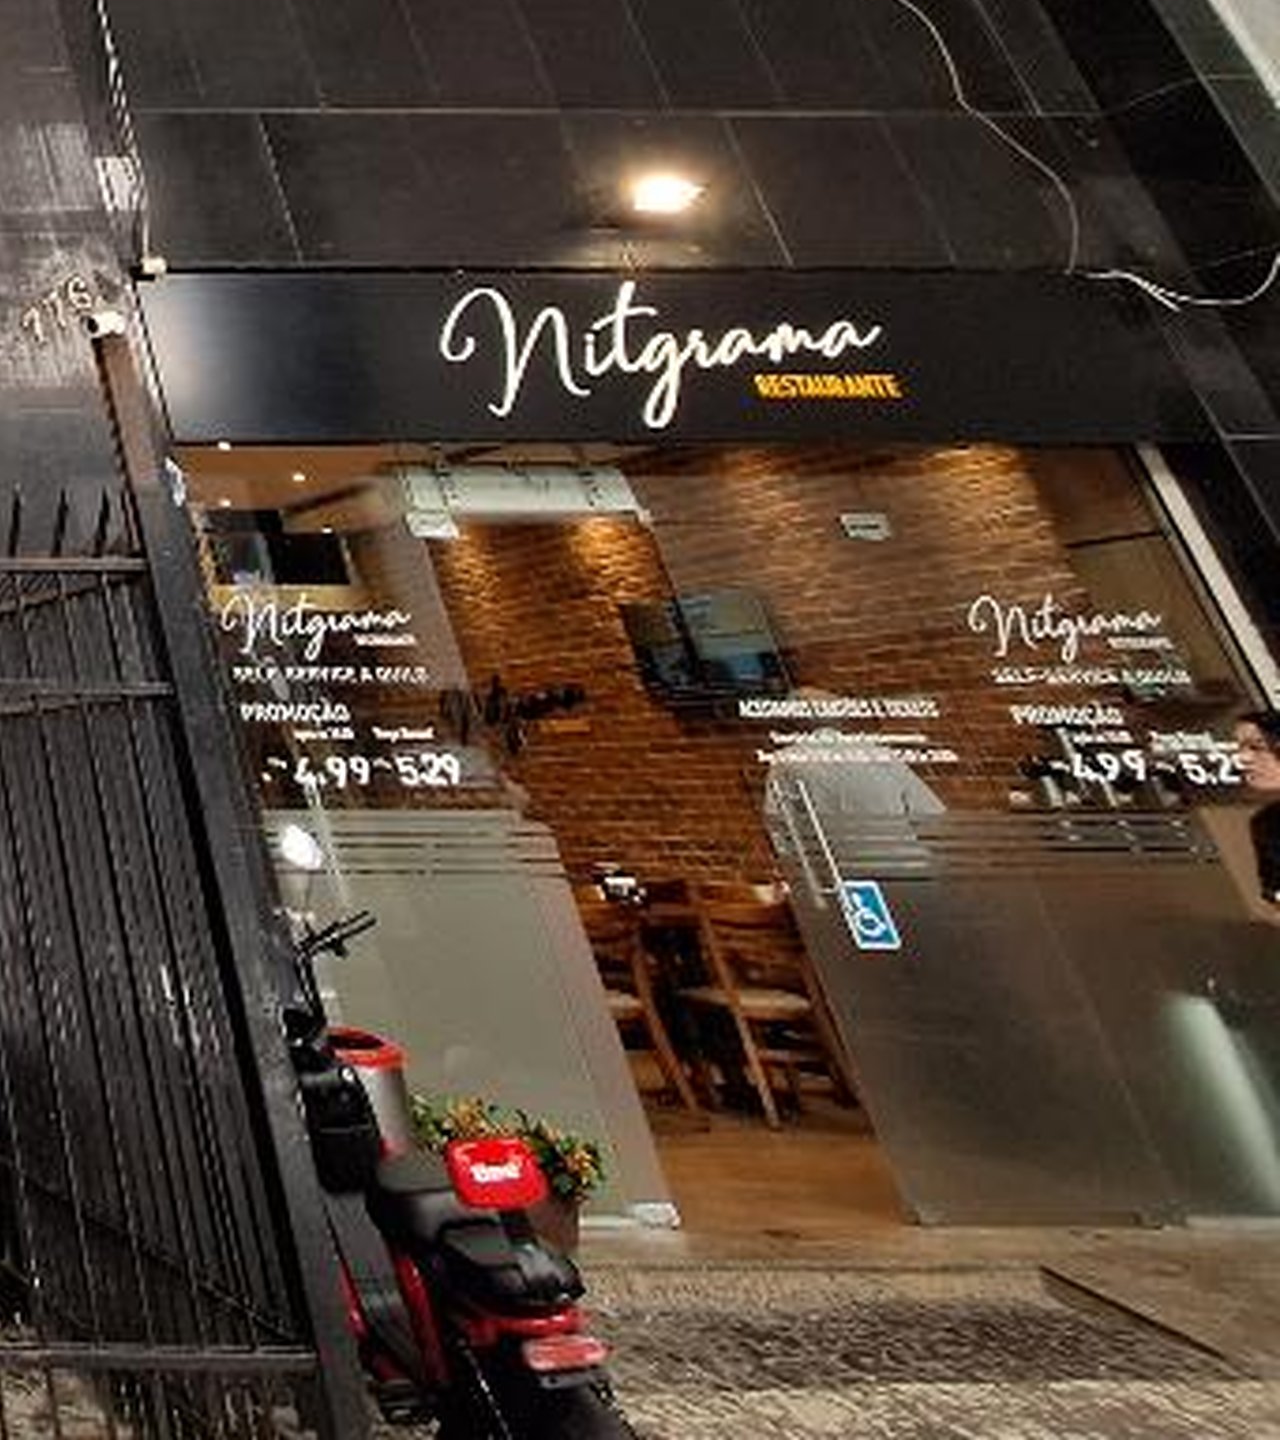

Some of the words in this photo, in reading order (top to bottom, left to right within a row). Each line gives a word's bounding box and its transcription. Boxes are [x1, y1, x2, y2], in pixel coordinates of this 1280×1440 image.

[439, 280, 882, 429] Nitgrama
[753, 372, 904, 400] RESTAURANTE
[220, 593, 412, 661] Nitgrama
[967, 592, 1163, 663] Nitgrama
